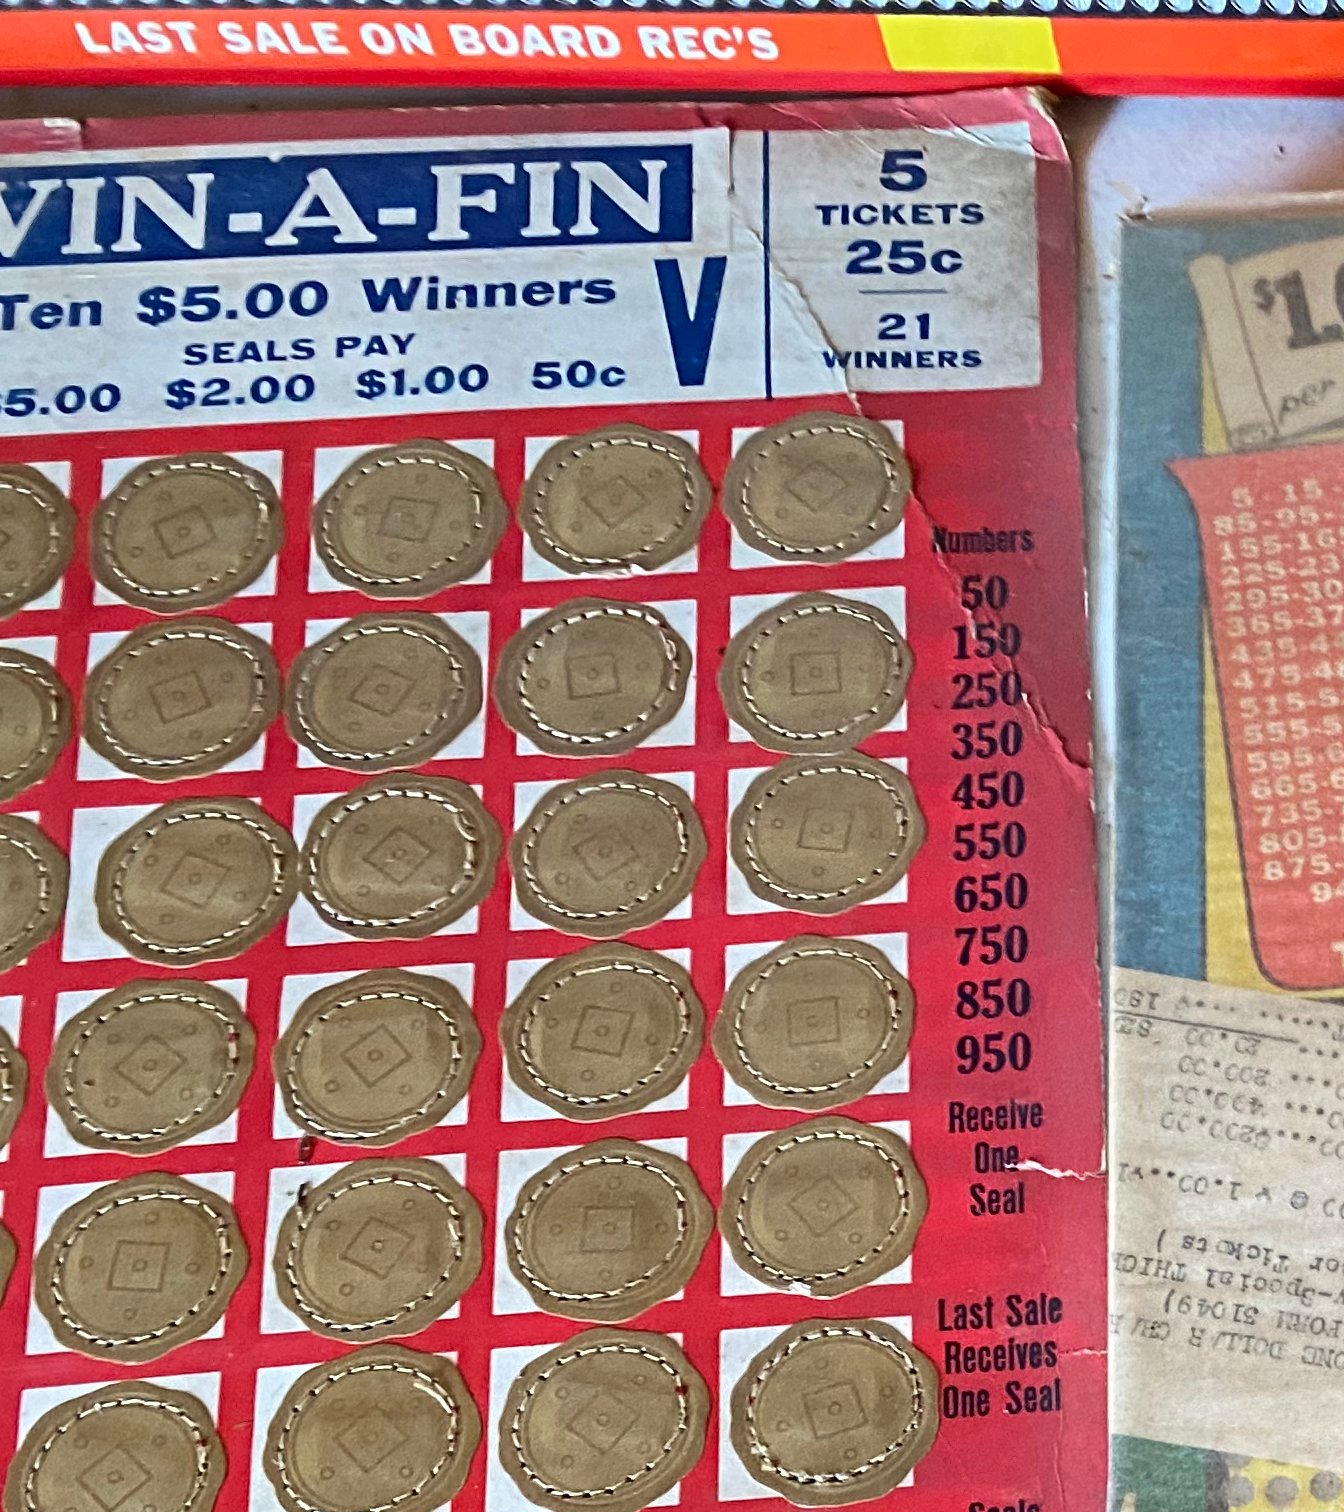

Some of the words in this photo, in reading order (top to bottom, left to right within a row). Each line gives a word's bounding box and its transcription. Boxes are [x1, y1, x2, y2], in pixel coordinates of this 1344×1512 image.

[76, 21, 200, 59] LAST
[221, 21, 348, 57] SALE
[359, 21, 430, 56] ON
[451, 22, 622, 60] BOARD
[643, 26, 780, 62] REC'S
[879, 150, 928, 192] 5
[815, 202, 984, 228] TICKETS
[137, 281, 329, 327] $5.00
[362, 273, 617, 314] Winners
[656, 256, 727, 387] V
[877, 314, 933, 341] 21
[183, 336, 316, 366] SEALS
[336, 332, 416, 360] PAY
[822, 345, 982, 373] WINNERS
[0, 384, 121, 418] 5.00
[165, 375, 316, 411] $2.00
[355, 364, 489, 401] $1.00
[1276, 378, 1332, 422] per
[931, 526, 1036, 555] Numbers
[960, 576, 1009, 612] 50
[952, 623, 1021, 660] 150
[951, 671, 1022, 709] 250
[951, 721, 1023, 760] 350
[952, 771, 1024, 810] 450
[952, 822, 1026, 860] 550
[954, 874, 1028, 913] 650
[955, 926, 1028, 964] 750
[955, 979, 1030, 1019] 850
[956, 1032, 1031, 1073] 950
[948, 1098, 1045, 1132] Receive
[974, 1144, 1020, 1174] One
[969, 1183, 1025, 1217] Seal
[937, 1298, 1000, 1332] Last
[1006, 1293, 1064, 1328] Sale
[943, 1340, 1059, 1375] Receives
[942, 1383, 994, 1418] One
[1004, 1379, 1063, 1414] Seal
